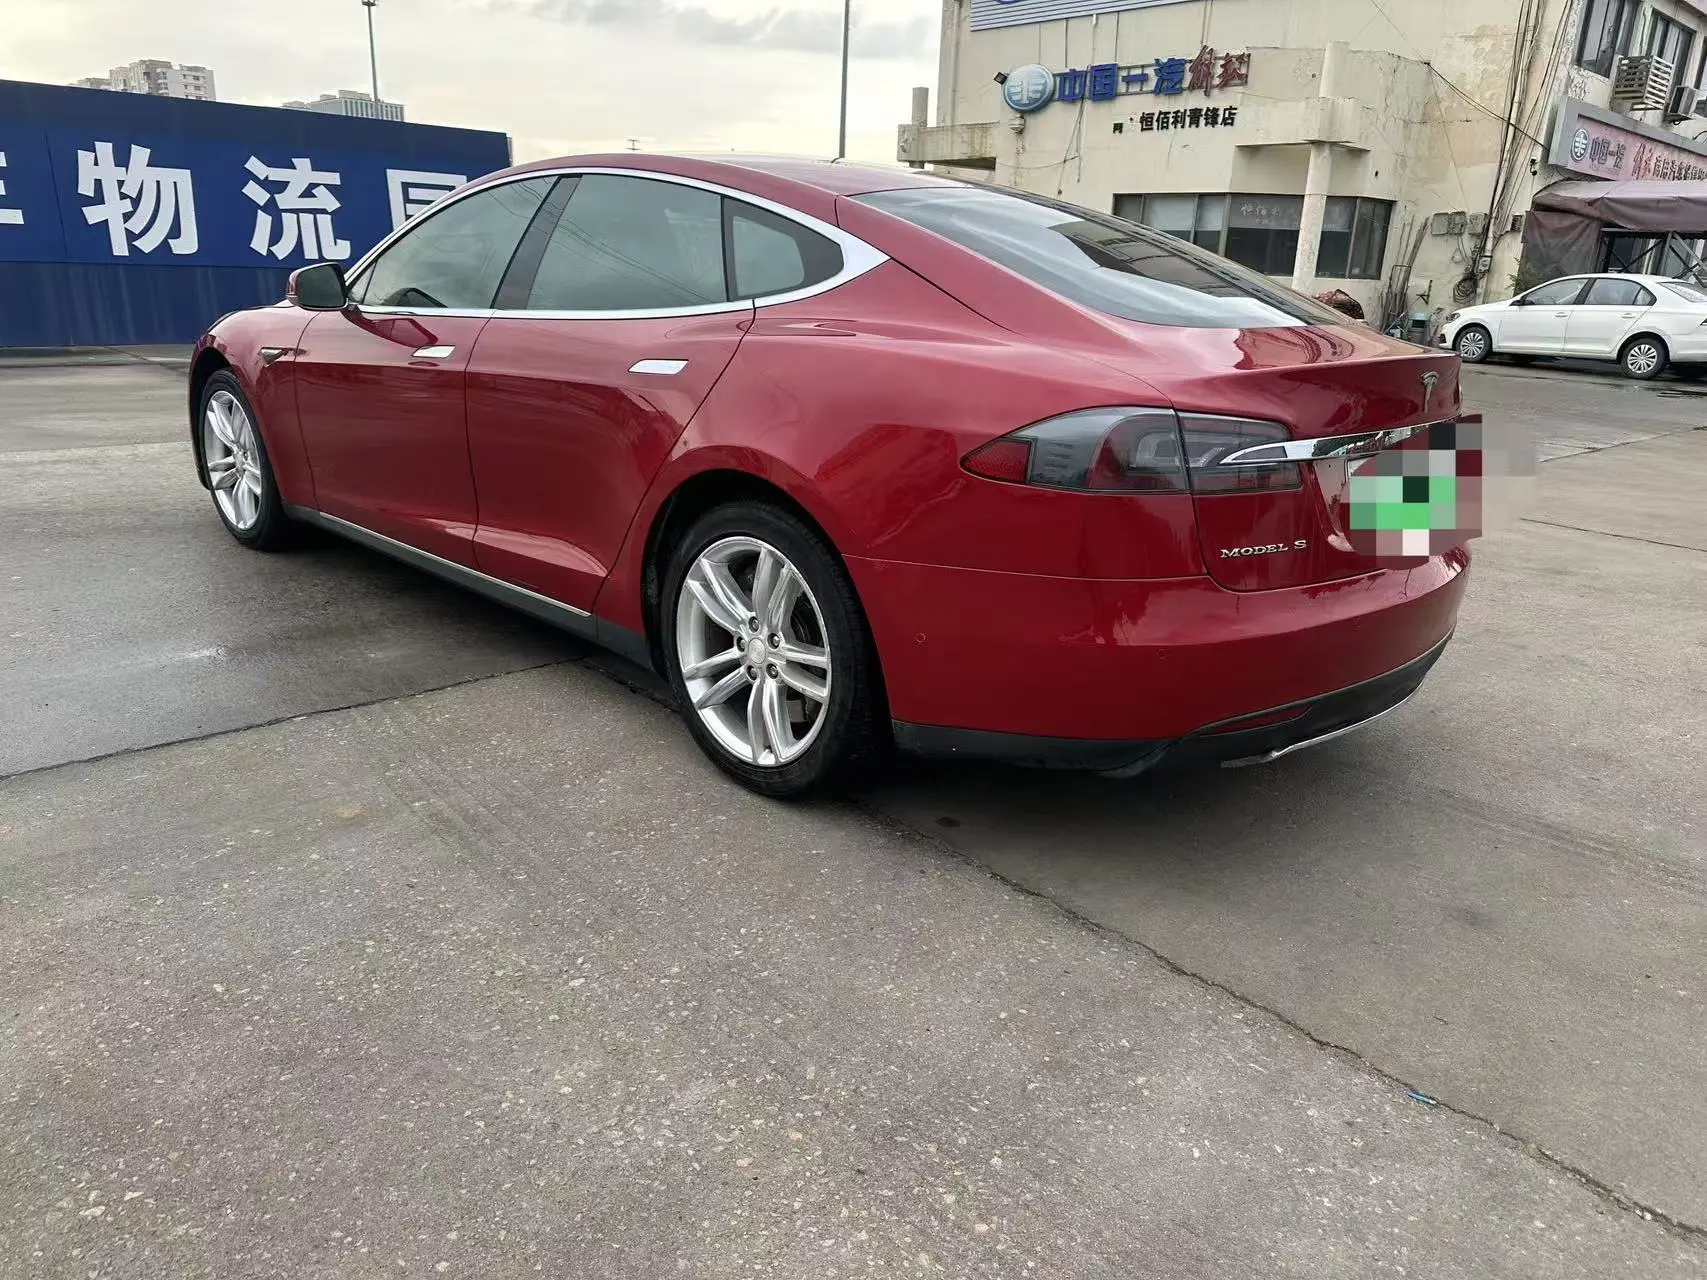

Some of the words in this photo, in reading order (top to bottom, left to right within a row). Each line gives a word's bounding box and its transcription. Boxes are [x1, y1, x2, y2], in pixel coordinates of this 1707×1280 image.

[1139, 106, 1238, 132] 恒佰利青锋店
[0, 141, 467, 260] 物流
[1220, 544, 1289, 558] MODEL
[1294, 540, 1307, 549] S
